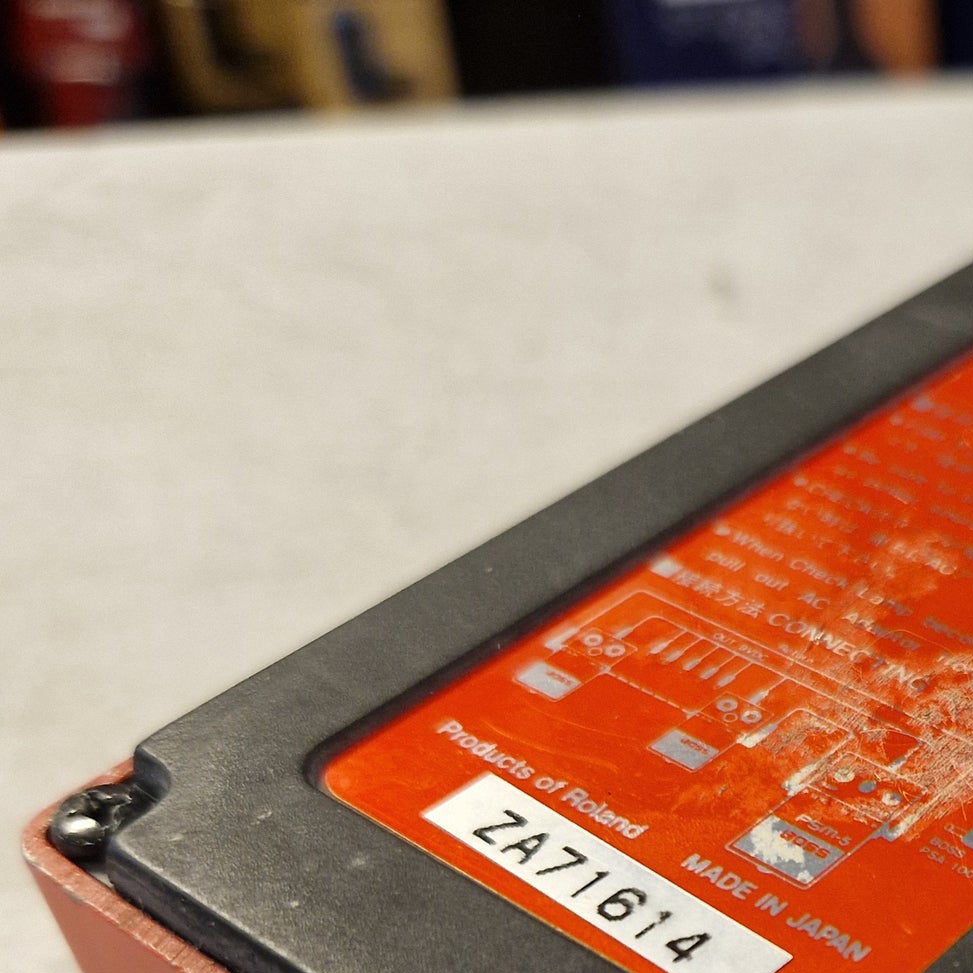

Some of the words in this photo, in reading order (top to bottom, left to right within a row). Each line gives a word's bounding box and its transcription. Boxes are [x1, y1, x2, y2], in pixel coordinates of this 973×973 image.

[699, 549, 748, 574] pull
[749, 570, 792, 592] out
[793, 590, 833, 611] AC
[724, 531, 791, 563] When
[783, 556, 855, 591] Check
[853, 586, 919, 619] Lamp
[760, 609, 937, 694] CONNECTING
[437, 719, 536, 780] Products
[536, 773, 565, 796] of
[563, 788, 648, 839] Roland
[473, 809, 713, 963] ZA71614
[681, 854, 758, 899] MADE
[756, 891, 787, 916] IN
[788, 916, 872, 962] JAPAN
